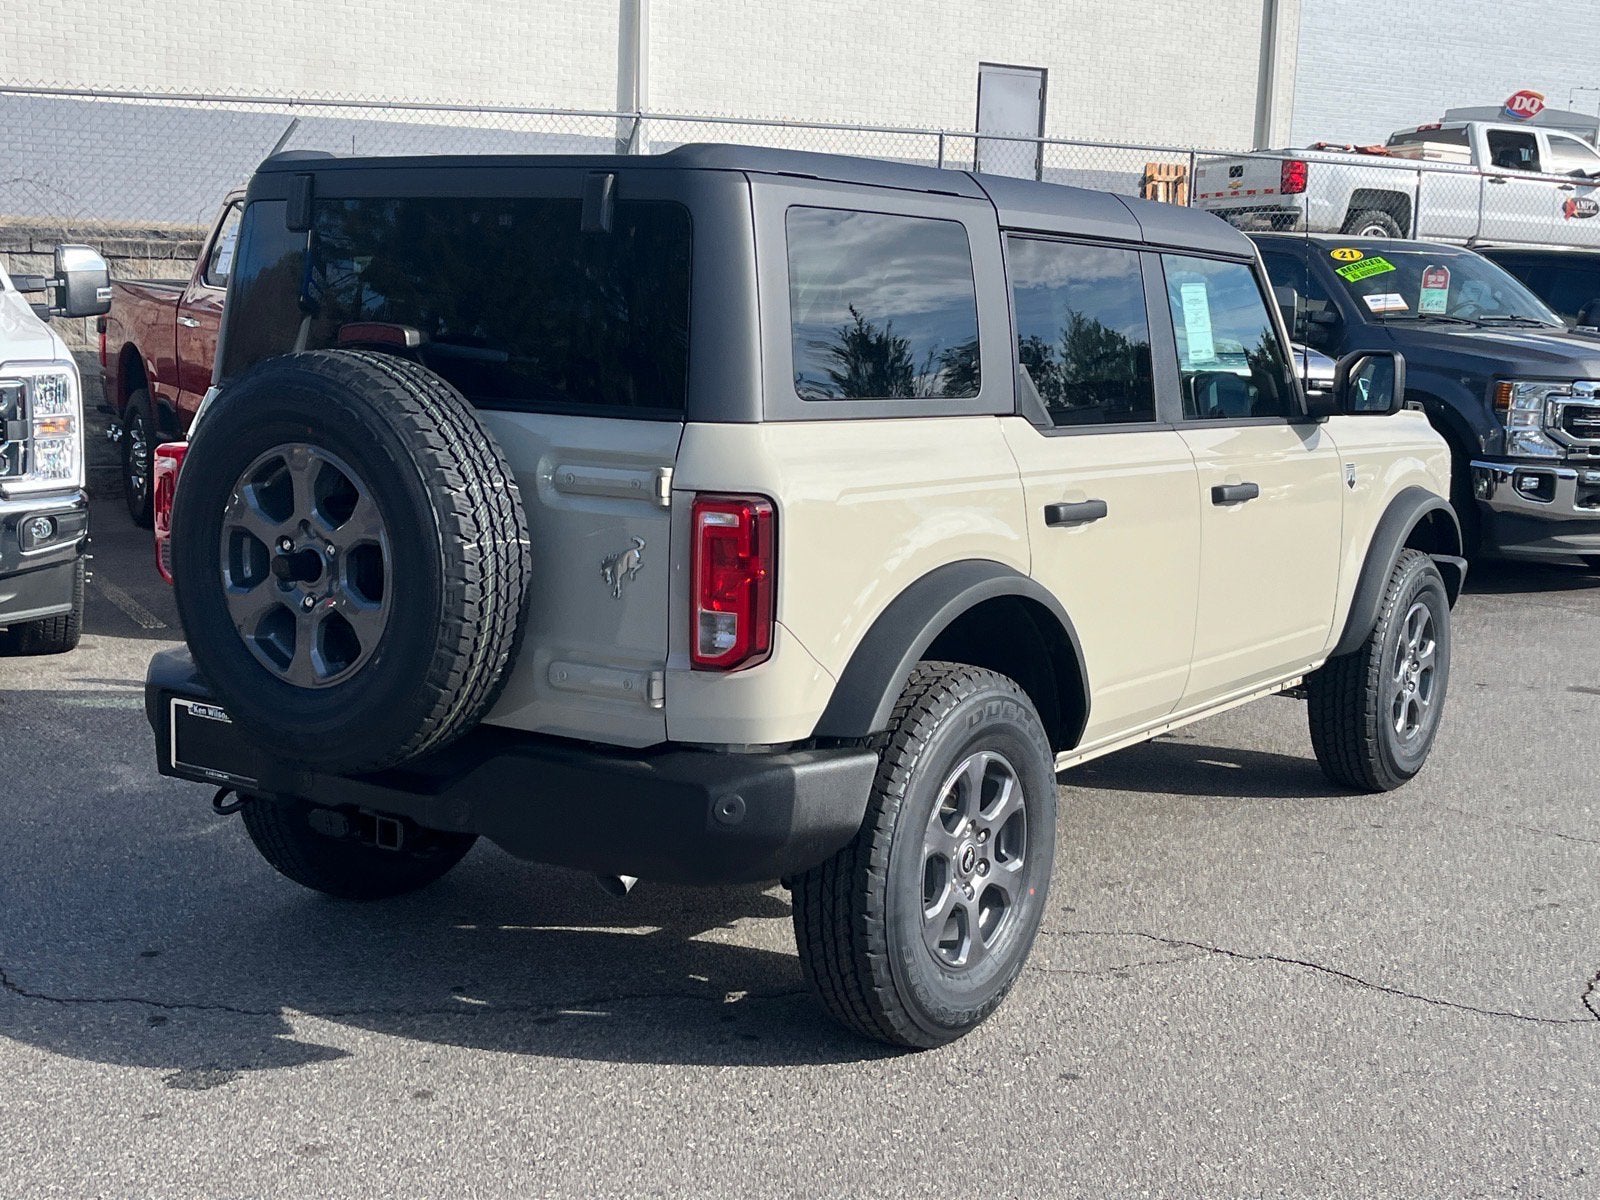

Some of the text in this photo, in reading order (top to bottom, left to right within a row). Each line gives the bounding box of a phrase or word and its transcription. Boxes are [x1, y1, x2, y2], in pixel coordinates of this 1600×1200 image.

[1511, 95, 1541, 113] DQ
[1339, 250, 1355, 259] 21
[1340, 258, 1382, 274] REDUCED
[193, 704, 207, 715] Ken
